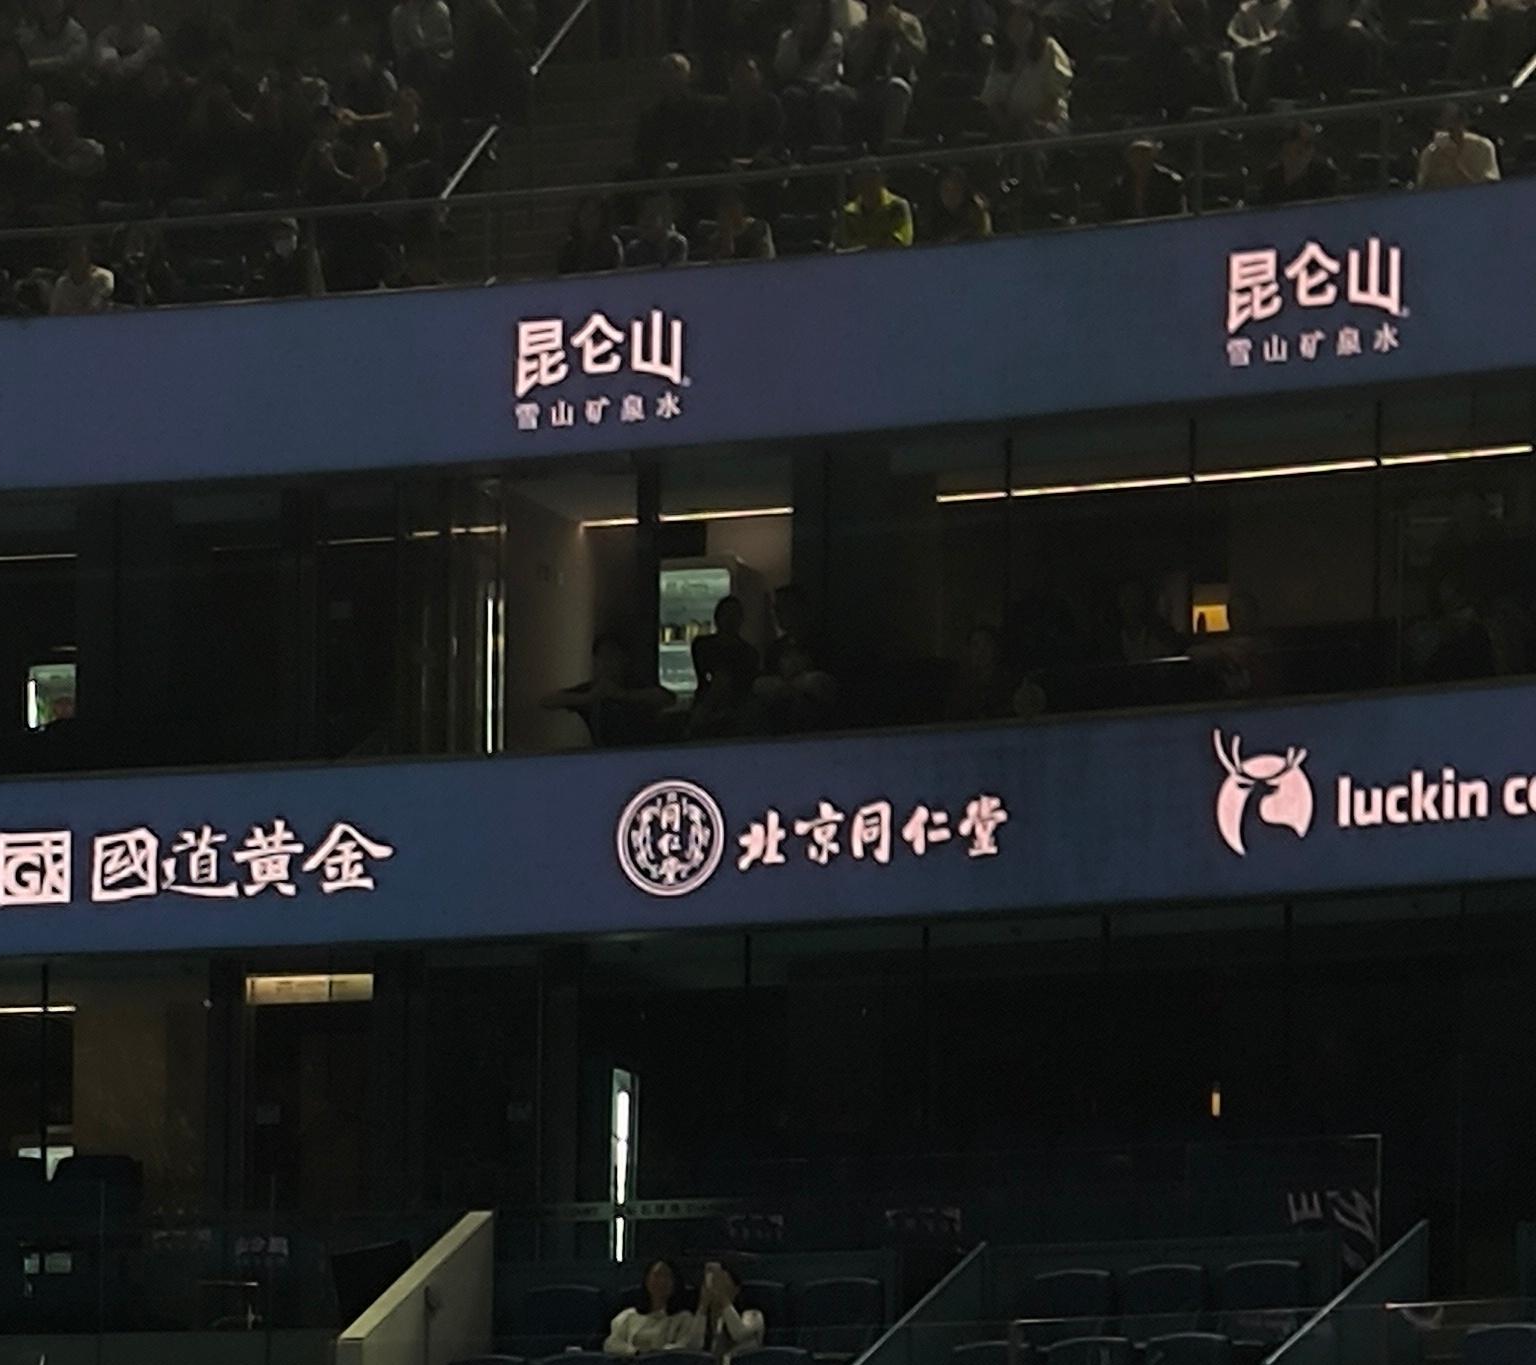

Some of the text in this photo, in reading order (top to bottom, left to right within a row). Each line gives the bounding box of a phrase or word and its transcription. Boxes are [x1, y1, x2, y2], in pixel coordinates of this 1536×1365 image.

[1227, 238, 1406, 332] 昆仑山
[516, 310, 684, 397] 昆仑山
[1227, 318, 1400, 366] 雪山矿泉水
[515, 391, 683, 430] 雪山矿泉水
[1337, 767, 1490, 828] luckin
[738, 795, 1008, 871] 北京同仁堂
